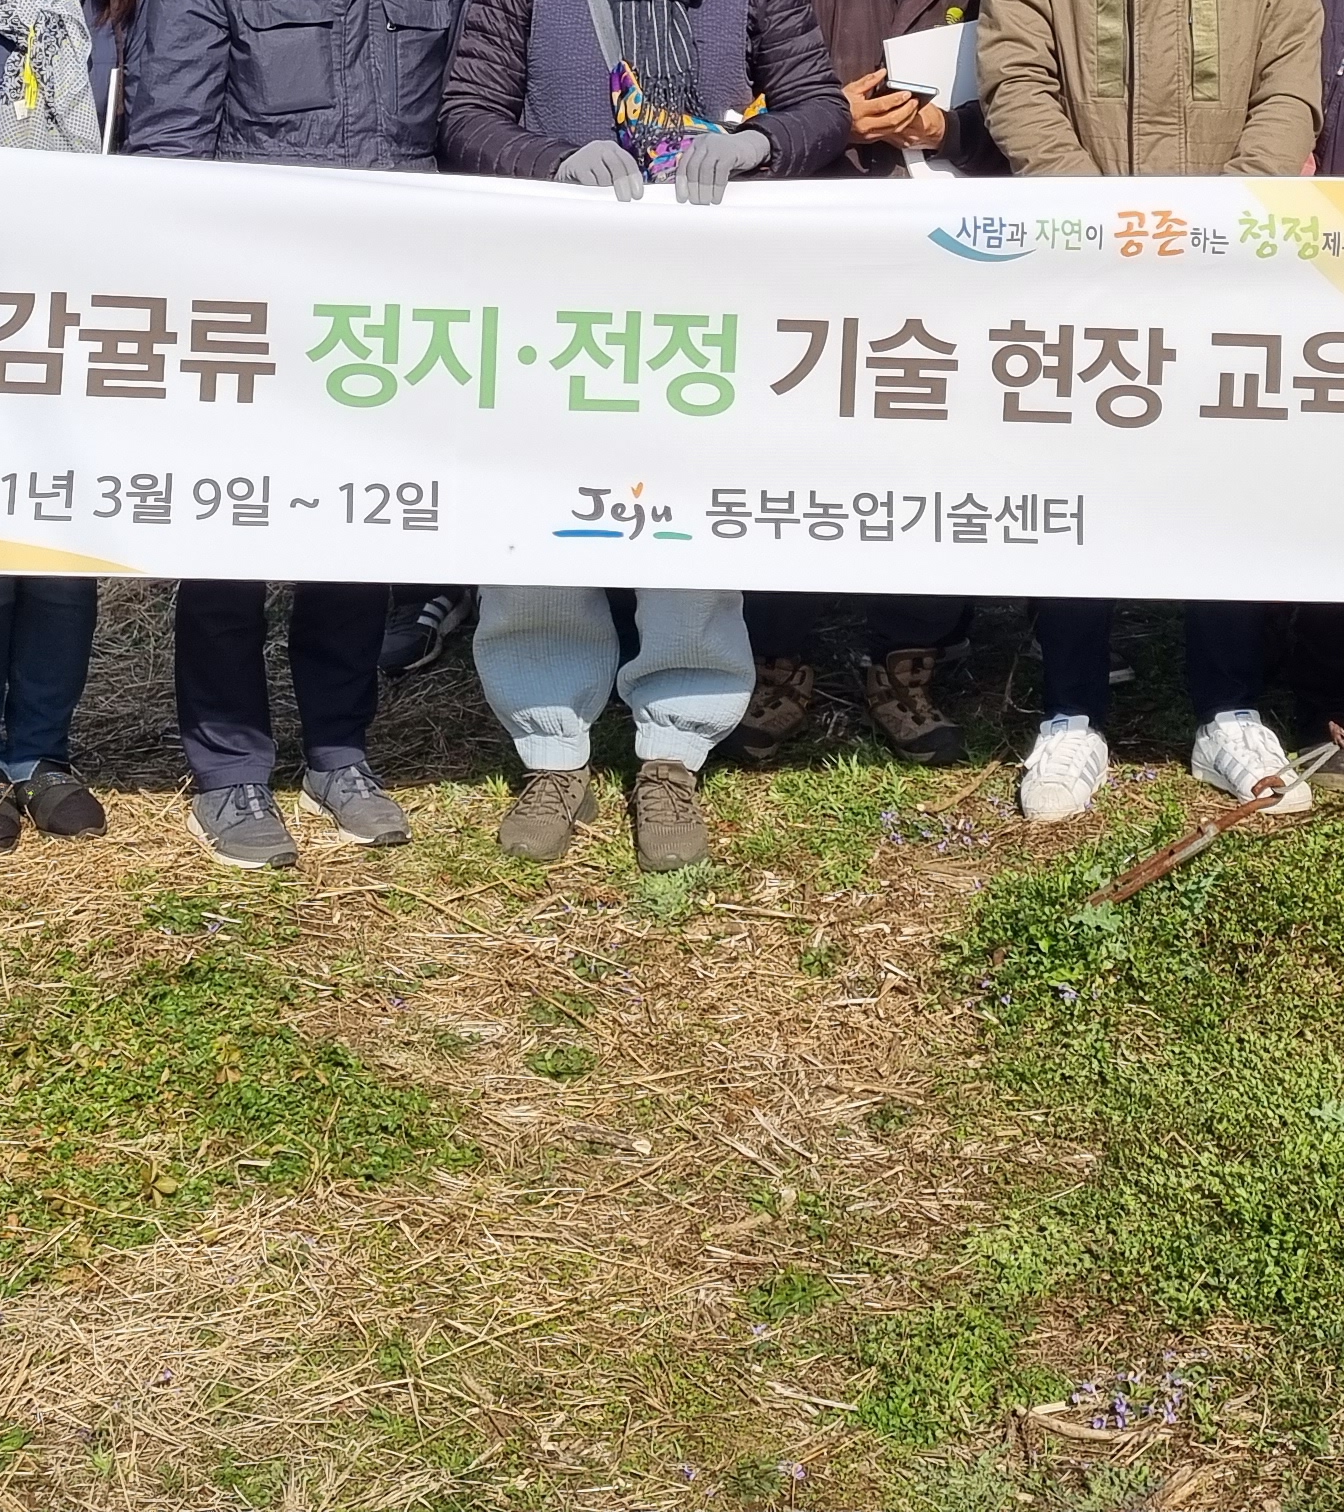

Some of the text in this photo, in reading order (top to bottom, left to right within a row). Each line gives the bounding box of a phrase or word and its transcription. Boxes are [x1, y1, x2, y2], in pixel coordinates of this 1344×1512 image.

[956, 215, 1028, 248] 사람과
[1035, 218, 1104, 251] 자연이
[1113, 209, 1230, 258] 공존하는
[305, 303, 739, 417] 정지·전정
[769, 316, 959, 421] 기술
[988, 319, 1177, 429] 현장
[92, 472, 173, 525] 3월
[192, 475, 271, 527] 9일
[338, 480, 439, 532] 12일
[570, 482, 1084, 546] Jeju 동부농업기술센터
